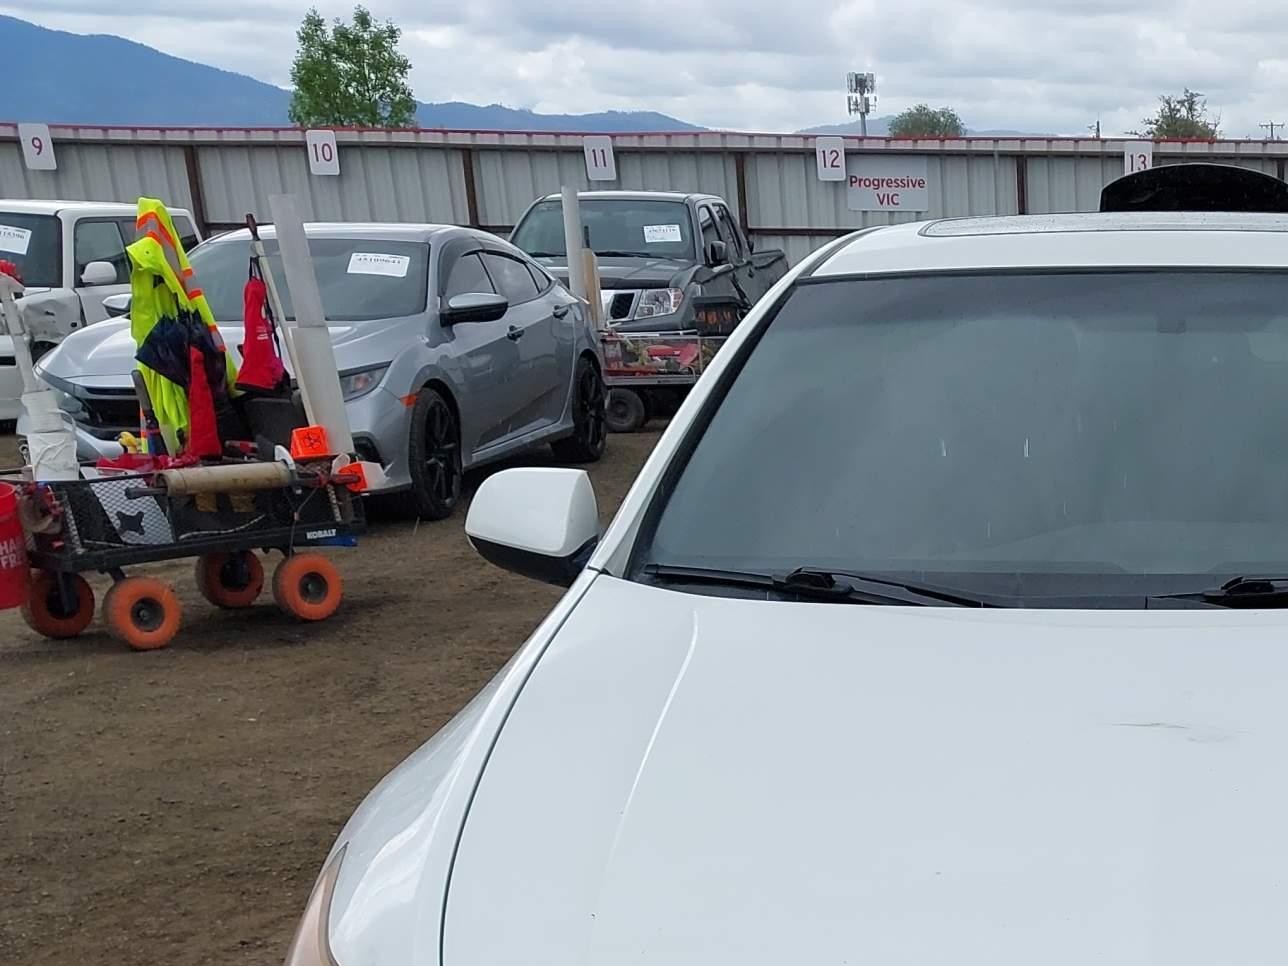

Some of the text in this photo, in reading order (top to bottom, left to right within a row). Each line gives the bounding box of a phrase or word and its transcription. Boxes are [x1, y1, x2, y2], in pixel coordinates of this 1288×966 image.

[32, 136, 43, 156] 9
[312, 143, 333, 162] 10
[591, 149, 607, 168] 11
[821, 149, 841, 169] 12
[1129, 153, 1147, 172] 13
[849, 175, 926, 191] Progressive
[876, 193, 900, 206] VIC
[306, 529, 337, 540] KOBALT
